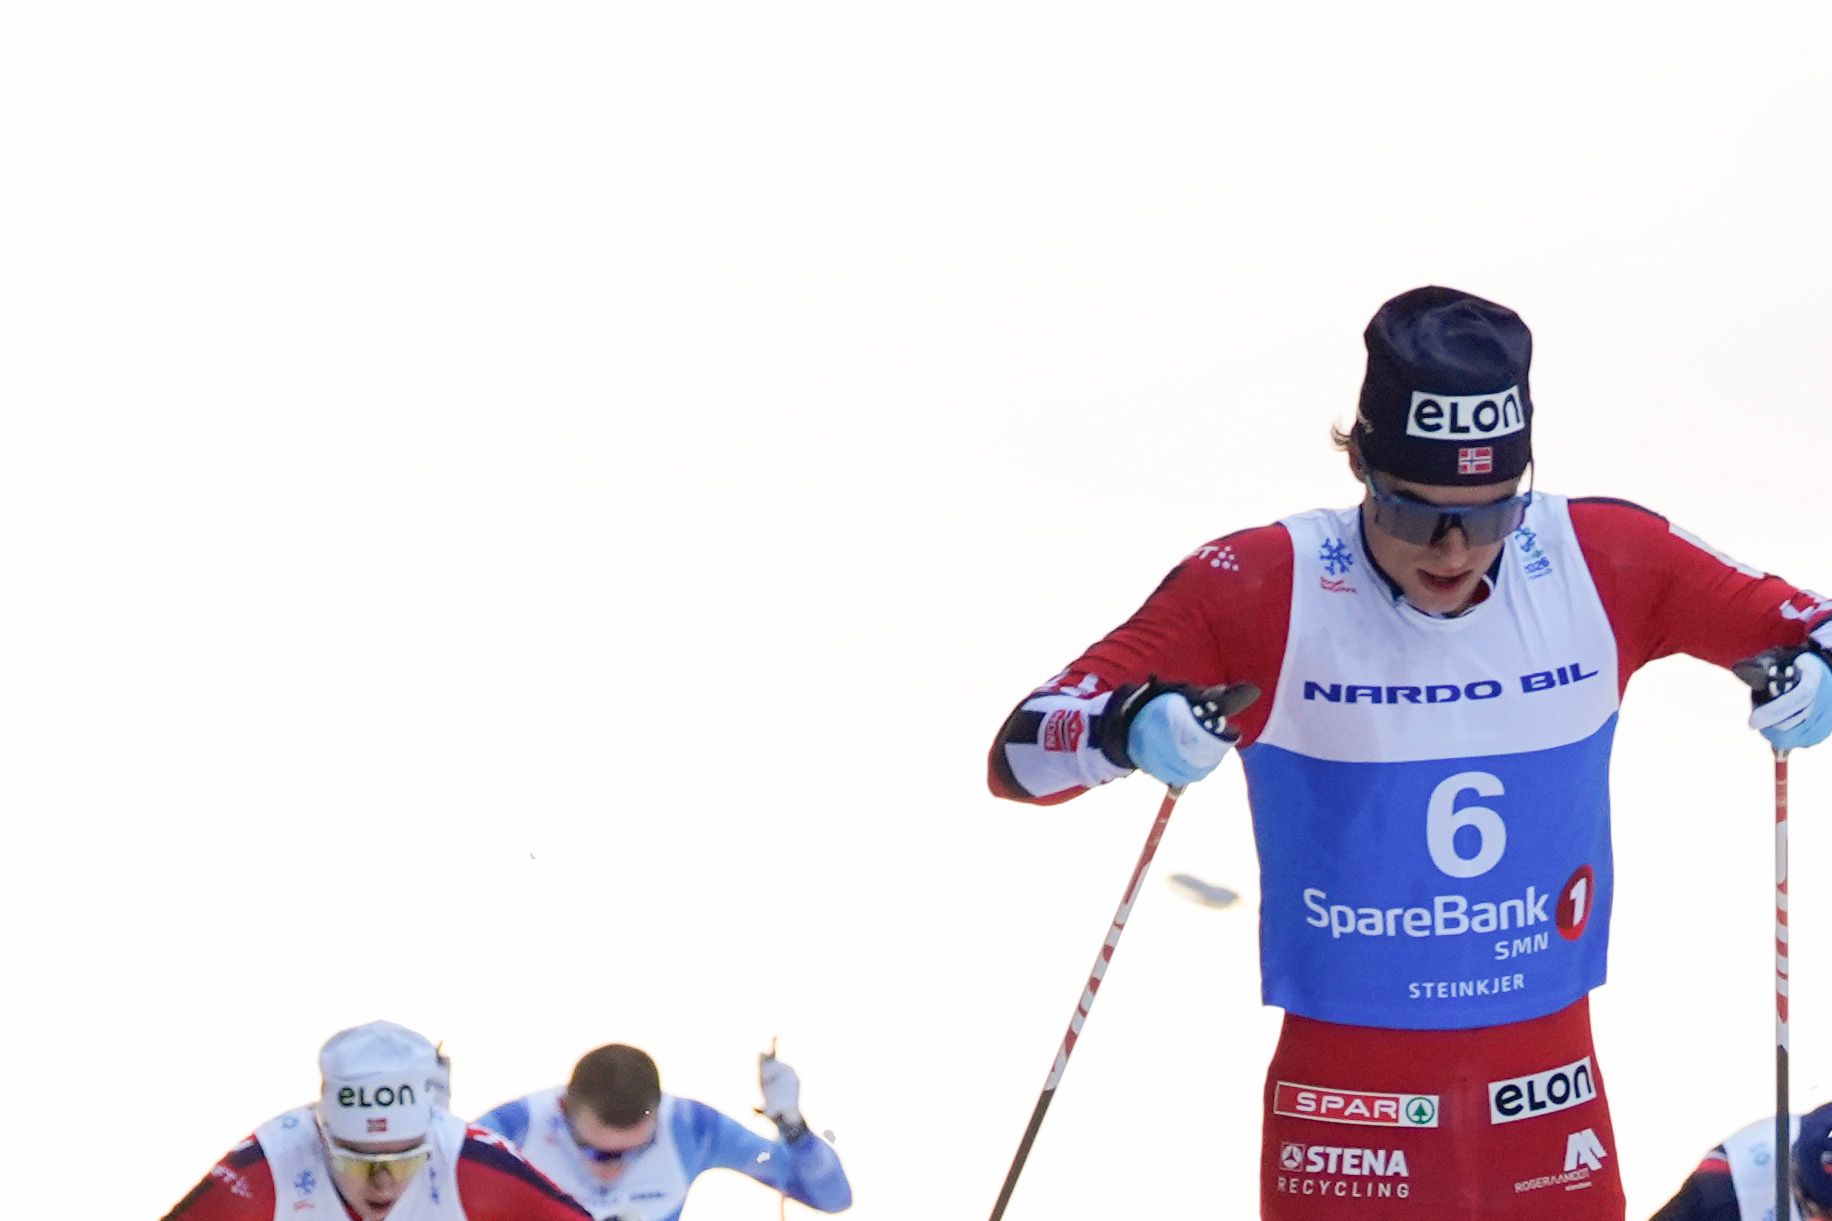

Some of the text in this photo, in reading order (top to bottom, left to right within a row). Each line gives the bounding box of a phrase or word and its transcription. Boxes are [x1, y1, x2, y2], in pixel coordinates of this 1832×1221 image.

[1304, 663, 1599, 704] NARDO BIL
[1427, 771, 1506, 878] 6
[1303, 886, 1549, 938] SpareBank
[1494, 931, 1549, 960] SMN
[1409, 974, 1524, 998] STEINKJER
[1296, 1092, 1397, 1119] SPAR
[1306, 1146, 1409, 1177] STENA
[1278, 1176, 1410, 1198] RECYCLING
